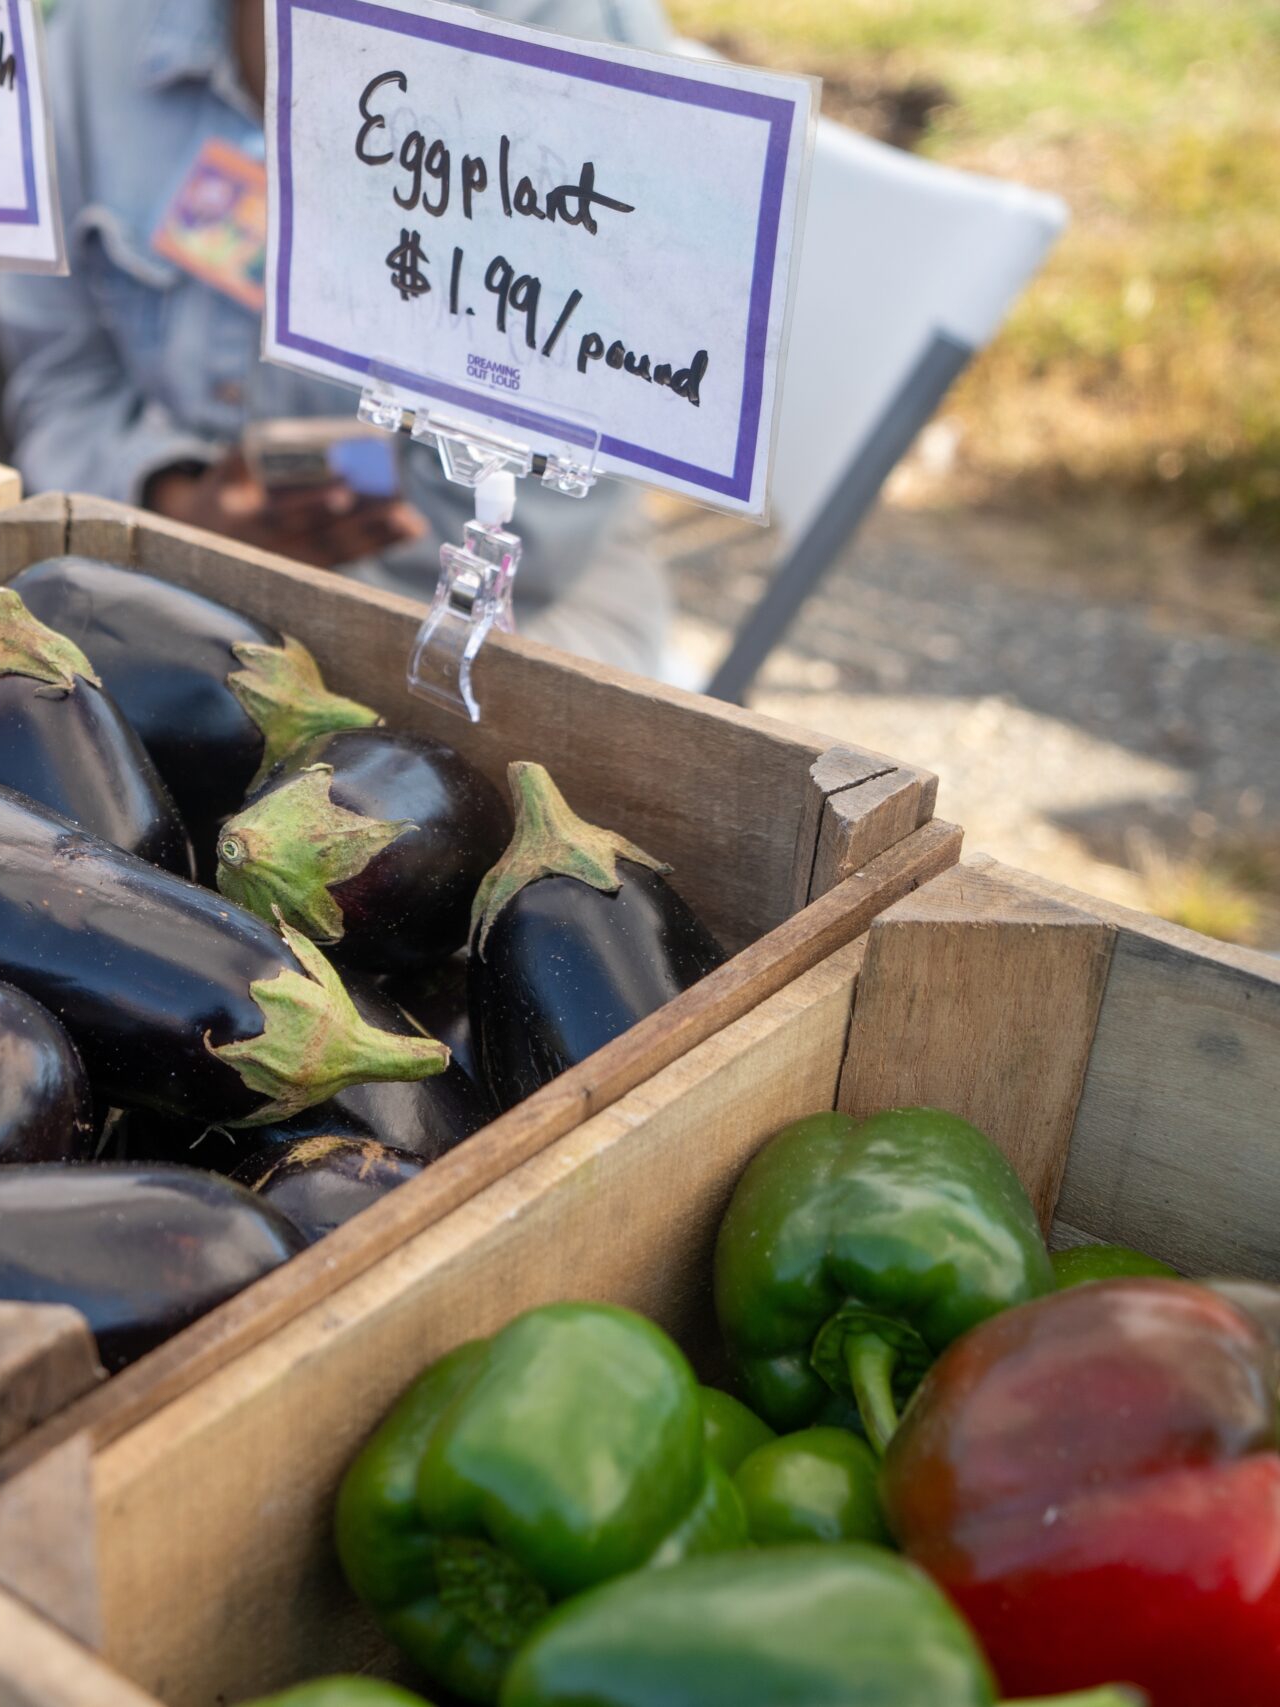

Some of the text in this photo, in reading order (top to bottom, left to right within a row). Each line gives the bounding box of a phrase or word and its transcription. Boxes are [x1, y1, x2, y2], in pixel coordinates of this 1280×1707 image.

[355, 70, 635, 235] Eggplant
[466, 365, 520, 390] OUT LOUD
[467, 354, 521, 380] DREAMING
